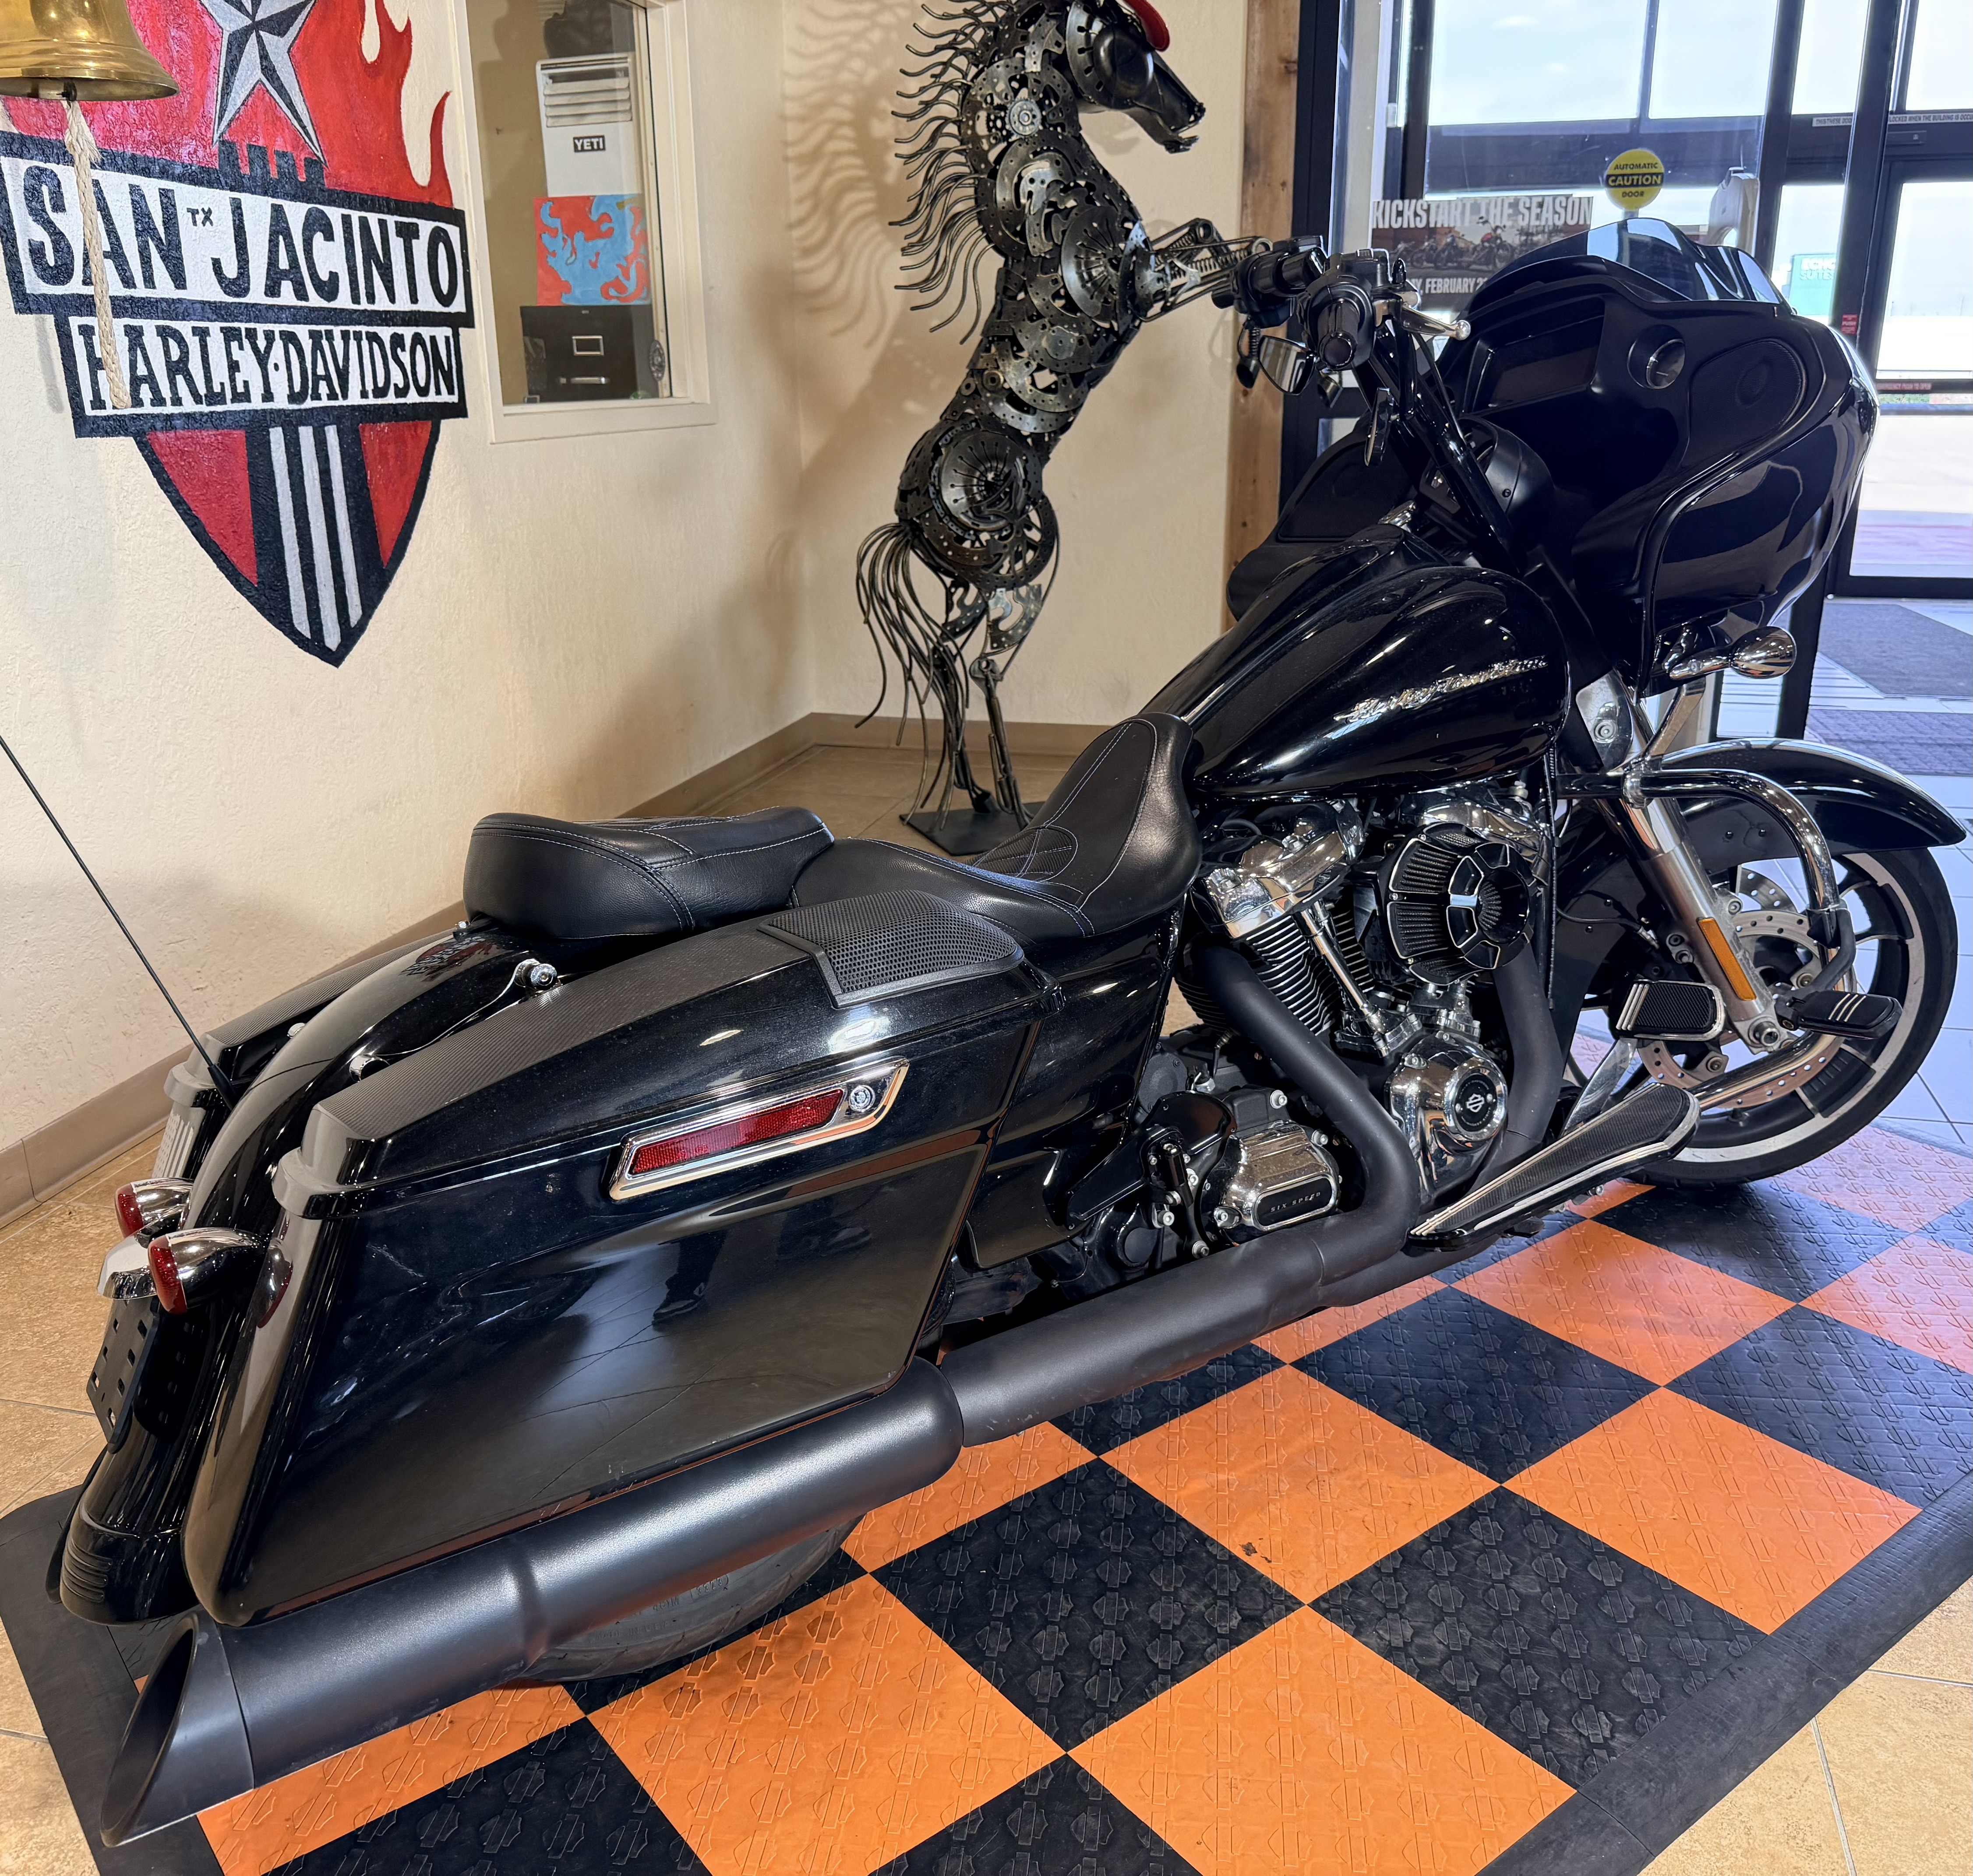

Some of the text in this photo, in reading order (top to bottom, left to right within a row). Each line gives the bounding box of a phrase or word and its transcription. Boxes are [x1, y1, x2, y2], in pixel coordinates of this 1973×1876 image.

[574, 137, 604, 151] YETI
[1608, 175, 1661, 186] CAUTION
[1373, 196, 1592, 229] KICKSTART THE SEASON
[23, 166, 459, 307] SAN TX JACINTO
[1426, 277, 1476, 294] FEBRUARY
[1271, 1192, 1321, 1212] SIX SPEED
